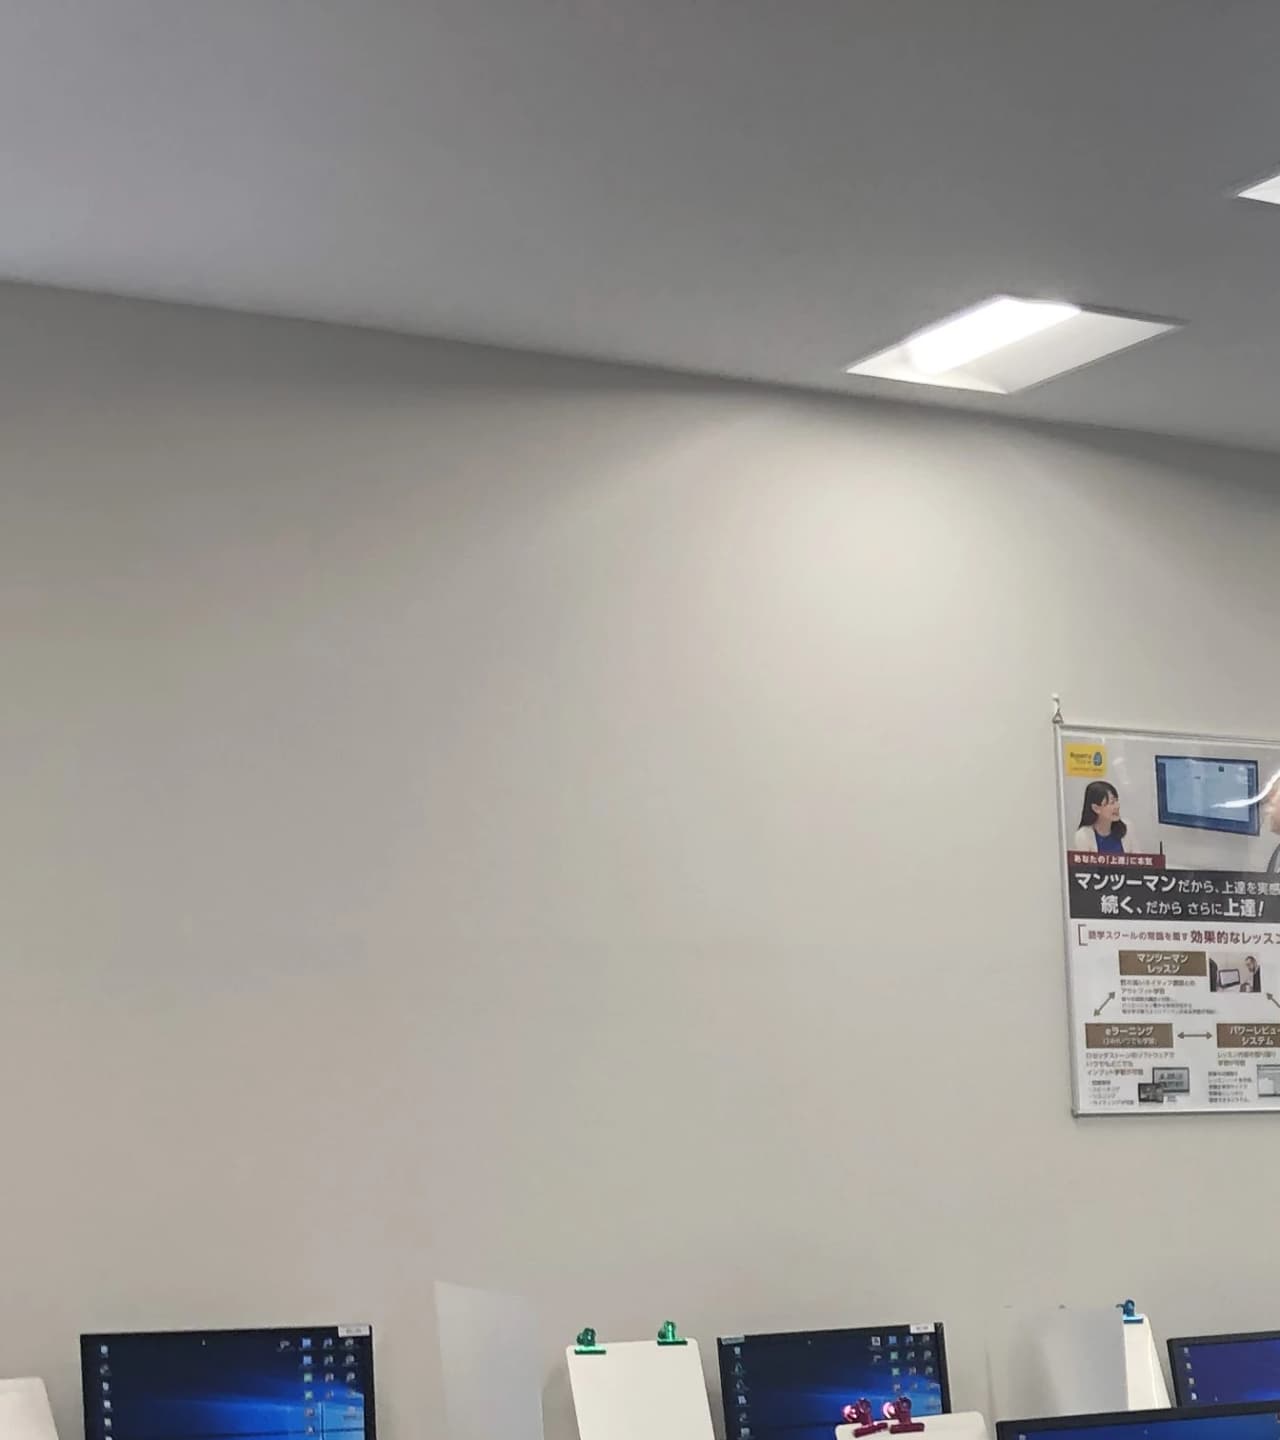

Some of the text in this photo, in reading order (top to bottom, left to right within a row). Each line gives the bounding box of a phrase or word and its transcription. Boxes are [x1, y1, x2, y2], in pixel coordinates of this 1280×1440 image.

[1137, 953, 1189, 963] マンツーマン
[1147, 964, 1180, 974] レッスン
[1105, 1026, 1154, 1036] eラーニング
[1242, 1036, 1274, 1046] システム
